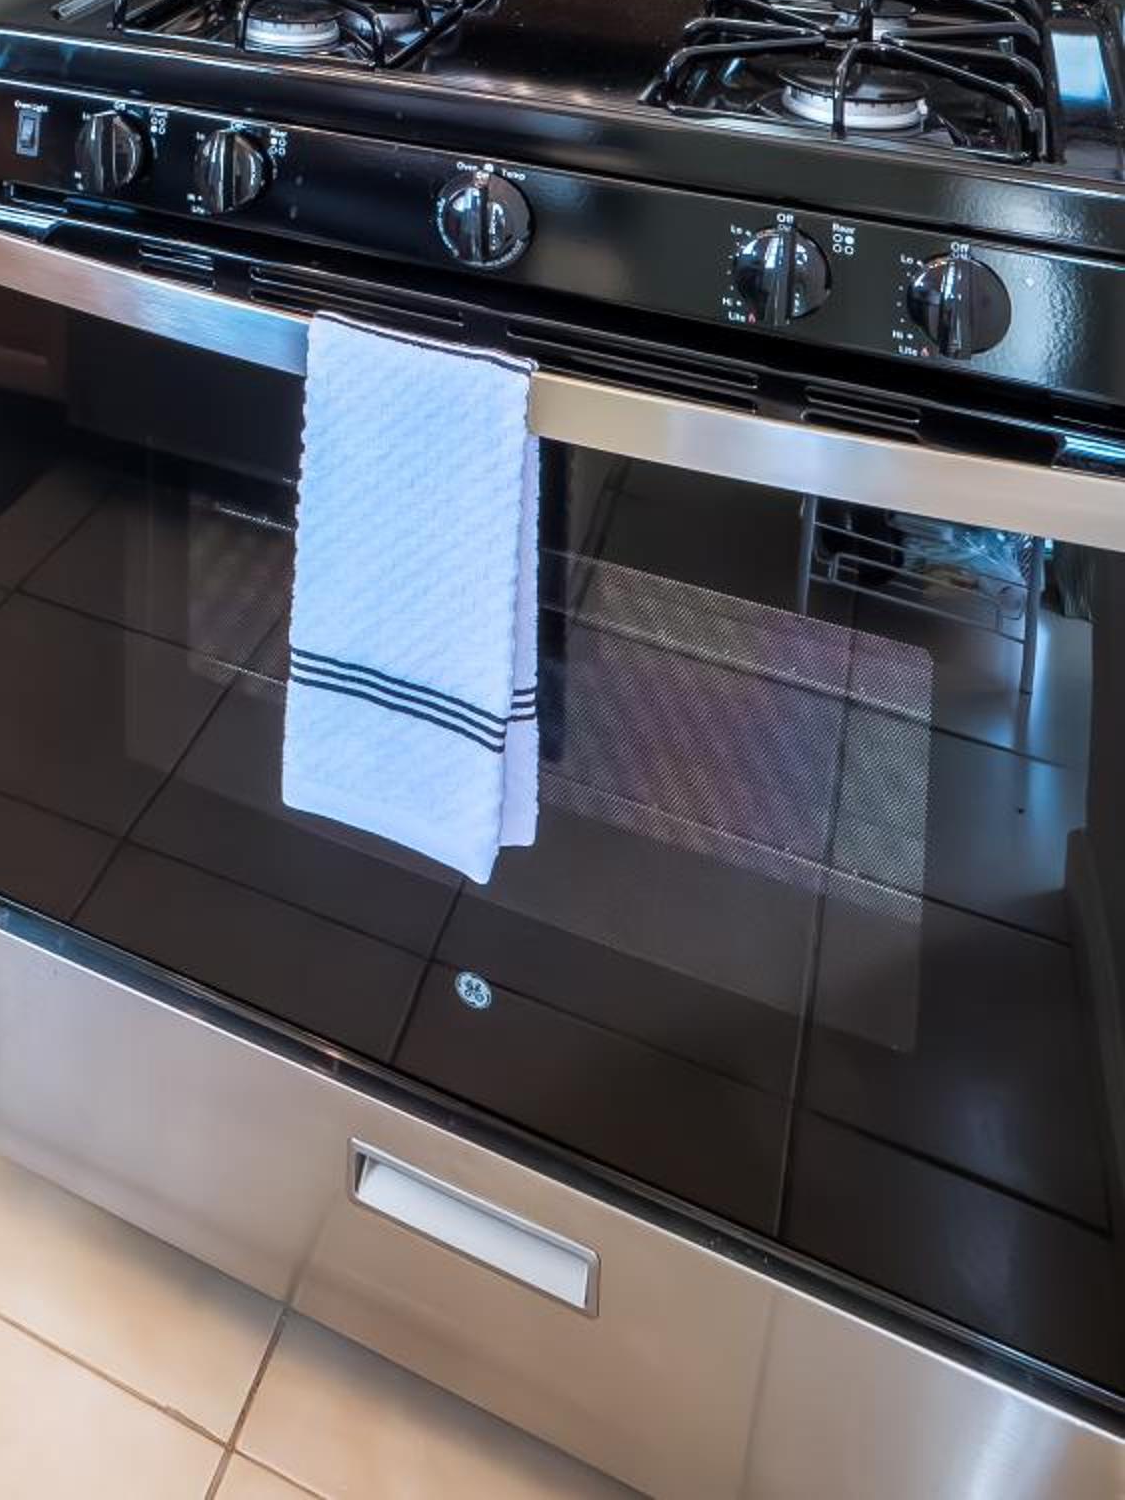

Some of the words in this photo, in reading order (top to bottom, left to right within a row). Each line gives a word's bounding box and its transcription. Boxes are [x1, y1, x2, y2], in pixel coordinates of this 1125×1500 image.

[777, 212, 794, 223] Off
[730, 224, 743, 235] Lo
[950, 241, 970, 253] Off
[900, 253, 914, 265] Lo
